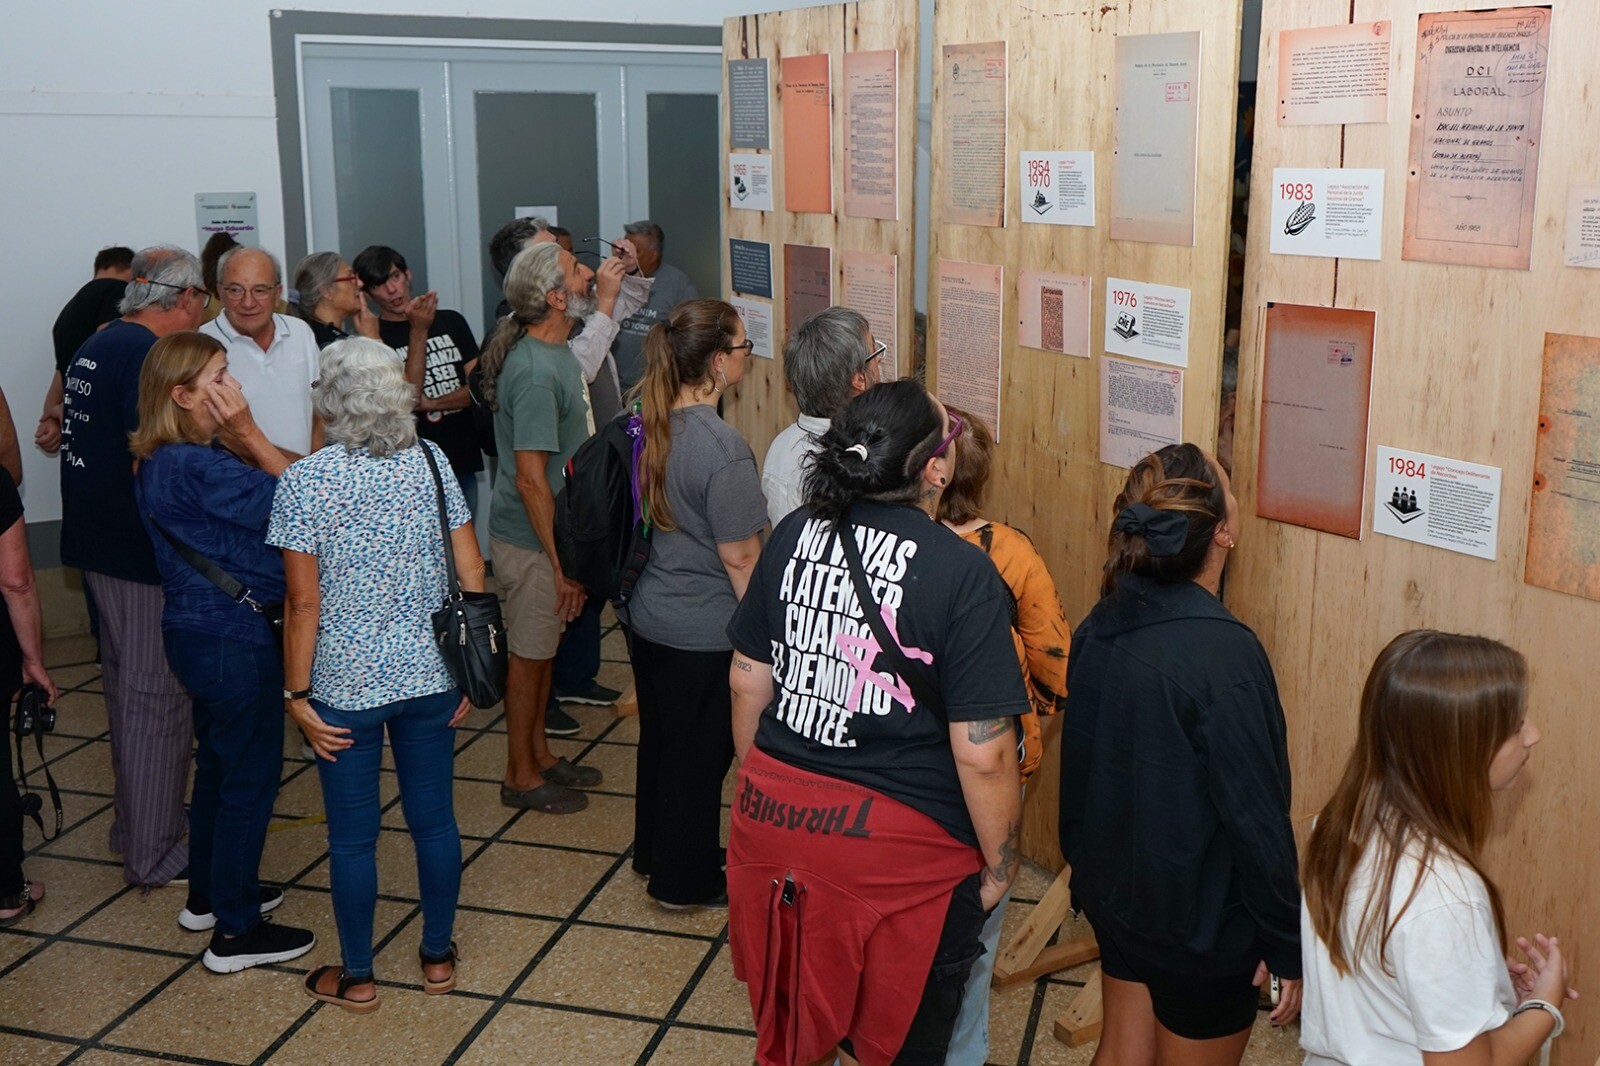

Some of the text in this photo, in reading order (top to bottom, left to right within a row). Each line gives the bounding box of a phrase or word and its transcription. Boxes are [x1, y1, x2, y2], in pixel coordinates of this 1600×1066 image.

[1454, 87, 1505, 96] LABORAL
[1028, 160, 1050, 174] 1954
[1028, 173, 1050, 188] 1970
[1280, 183, 1313, 200] 1983
[1113, 290, 1137, 308] 1976
[1118, 316, 1130, 330] CHE
[432, 364, 458, 381] SER
[1389, 457, 1426, 479] 1984
[792, 518, 832, 562] NO
[780, 558, 796, 602] A
[770, 640, 784, 684] EL
[784, 648, 894, 716] DEMONIO
[749, 766, 792, 783] MAGAZINE
[740, 773, 875, 838] THRASHER
